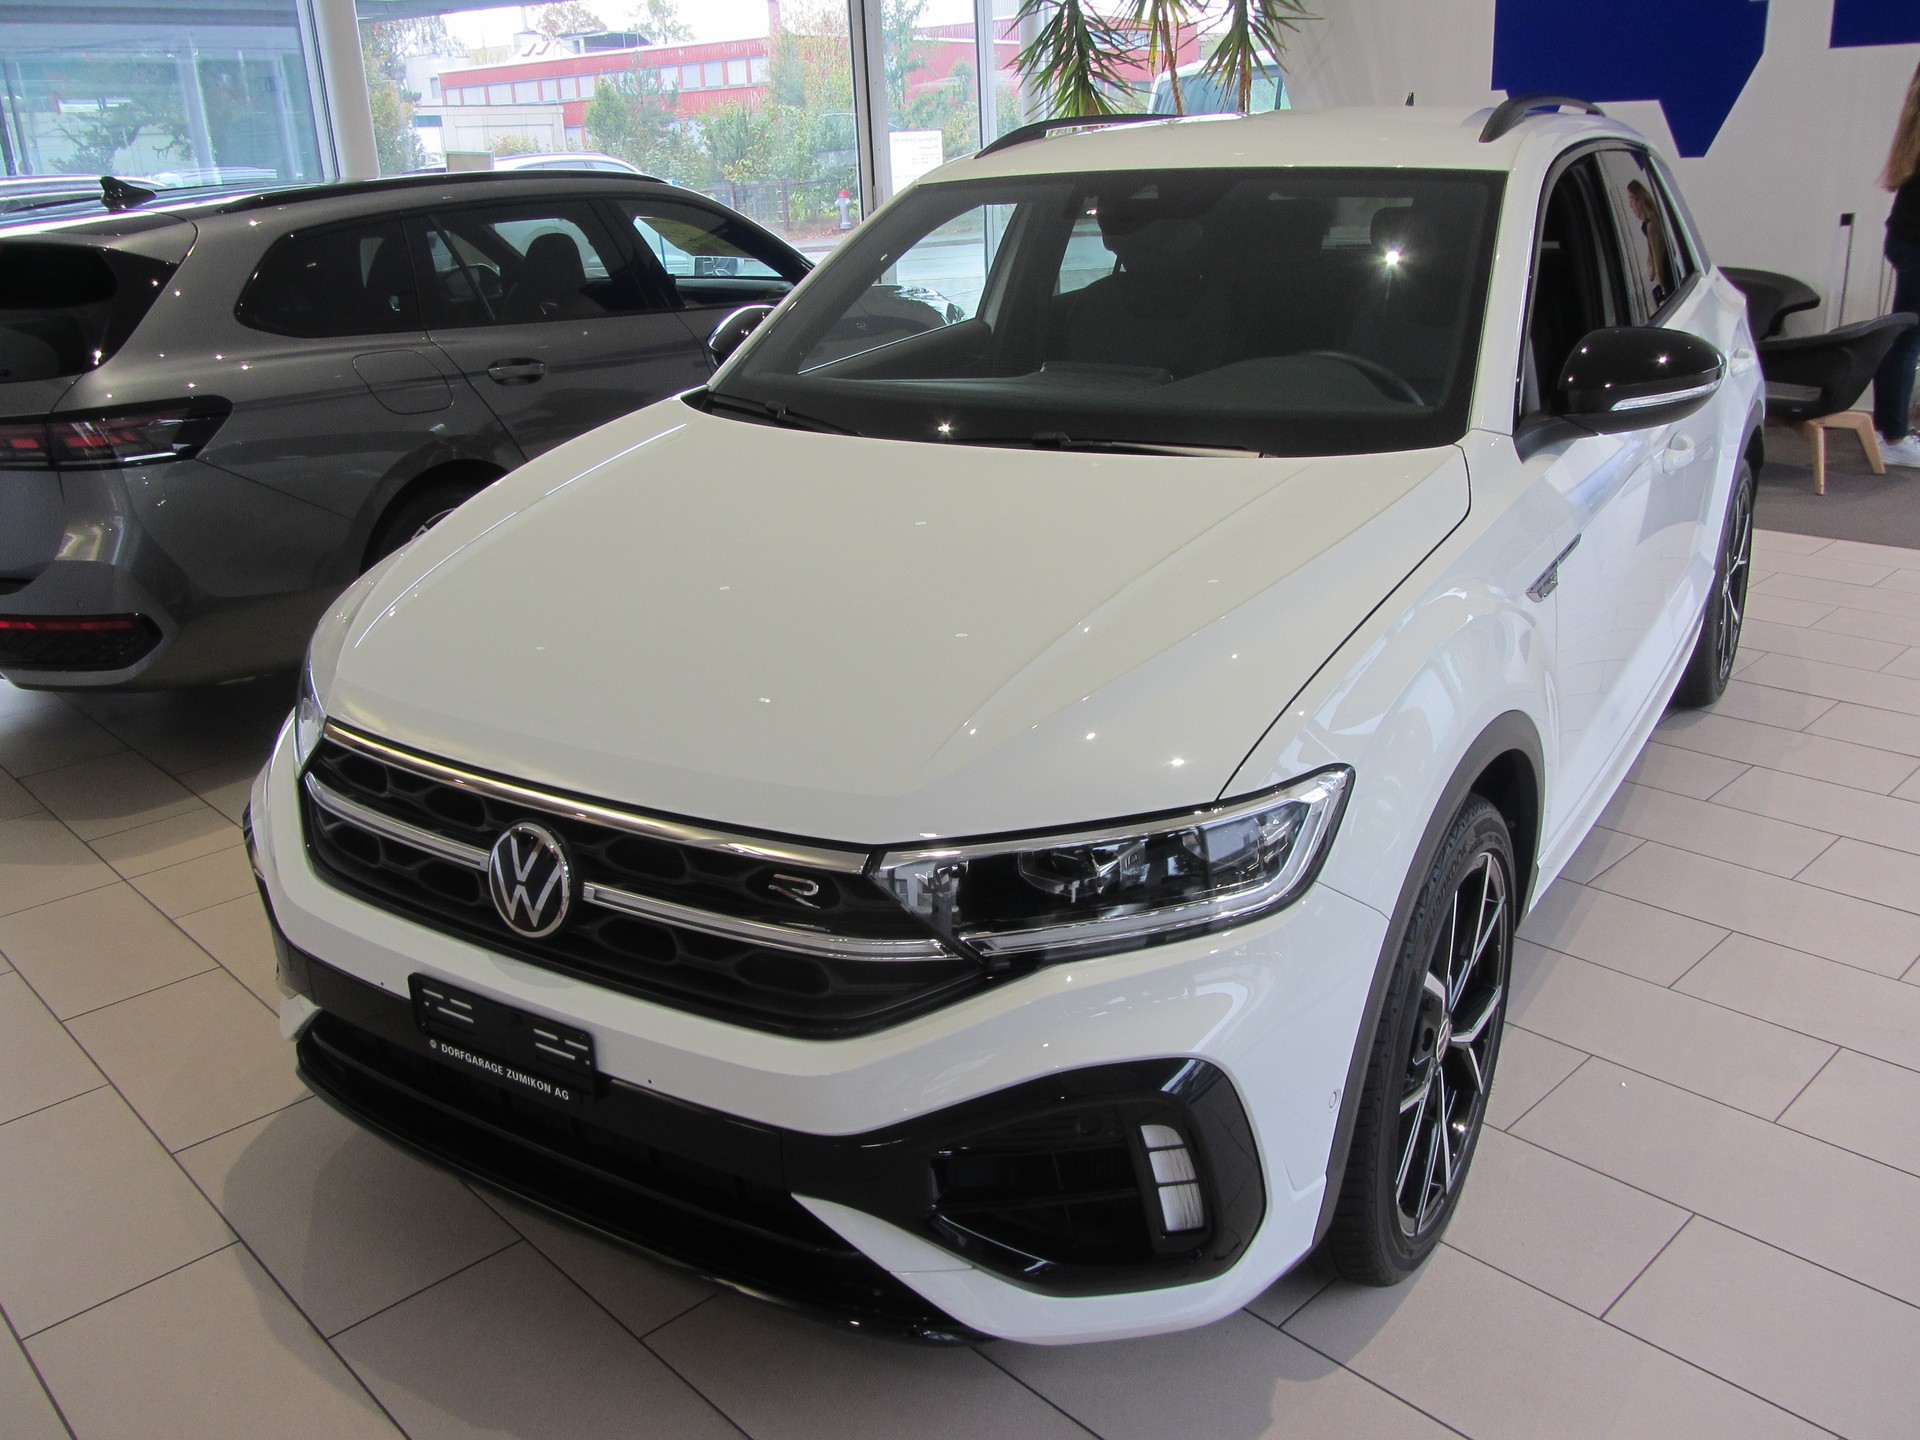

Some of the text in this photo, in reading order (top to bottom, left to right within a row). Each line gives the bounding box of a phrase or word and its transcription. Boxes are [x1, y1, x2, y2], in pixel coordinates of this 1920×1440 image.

[489, 823, 570, 938] VW
[768, 873, 820, 909] R
[441, 1043, 569, 1100] DORFGARAGE ZUMIKON AG
